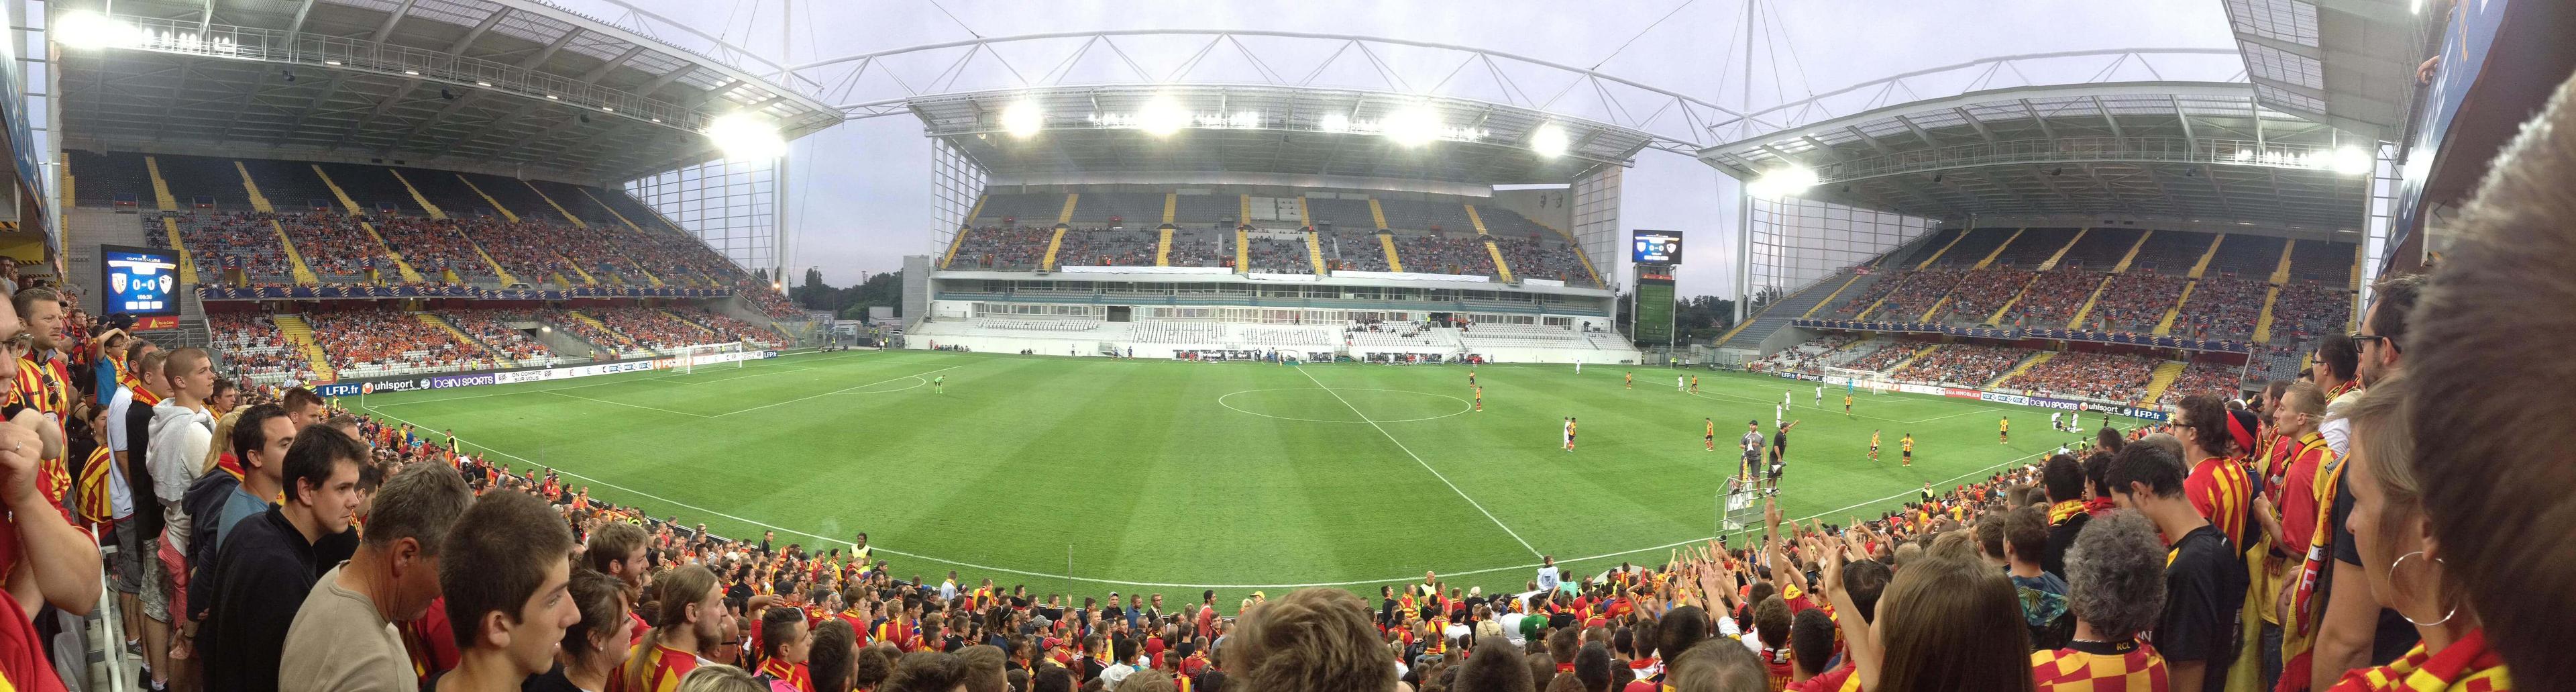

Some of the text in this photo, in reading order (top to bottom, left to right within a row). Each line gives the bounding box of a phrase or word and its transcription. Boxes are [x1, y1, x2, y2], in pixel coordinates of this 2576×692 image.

[375, 380, 413, 391] uhlsport
[435, 376, 493, 388] beIN SPORTS
[326, 386, 358, 395] LFP.fr
[2030, 399, 2077, 410] beIN SPORTS
[2088, 404, 2118, 413] uhlsport
[2135, 409, 2160, 419] LFP.fr
[2116, 642, 2131, 650] RCL
